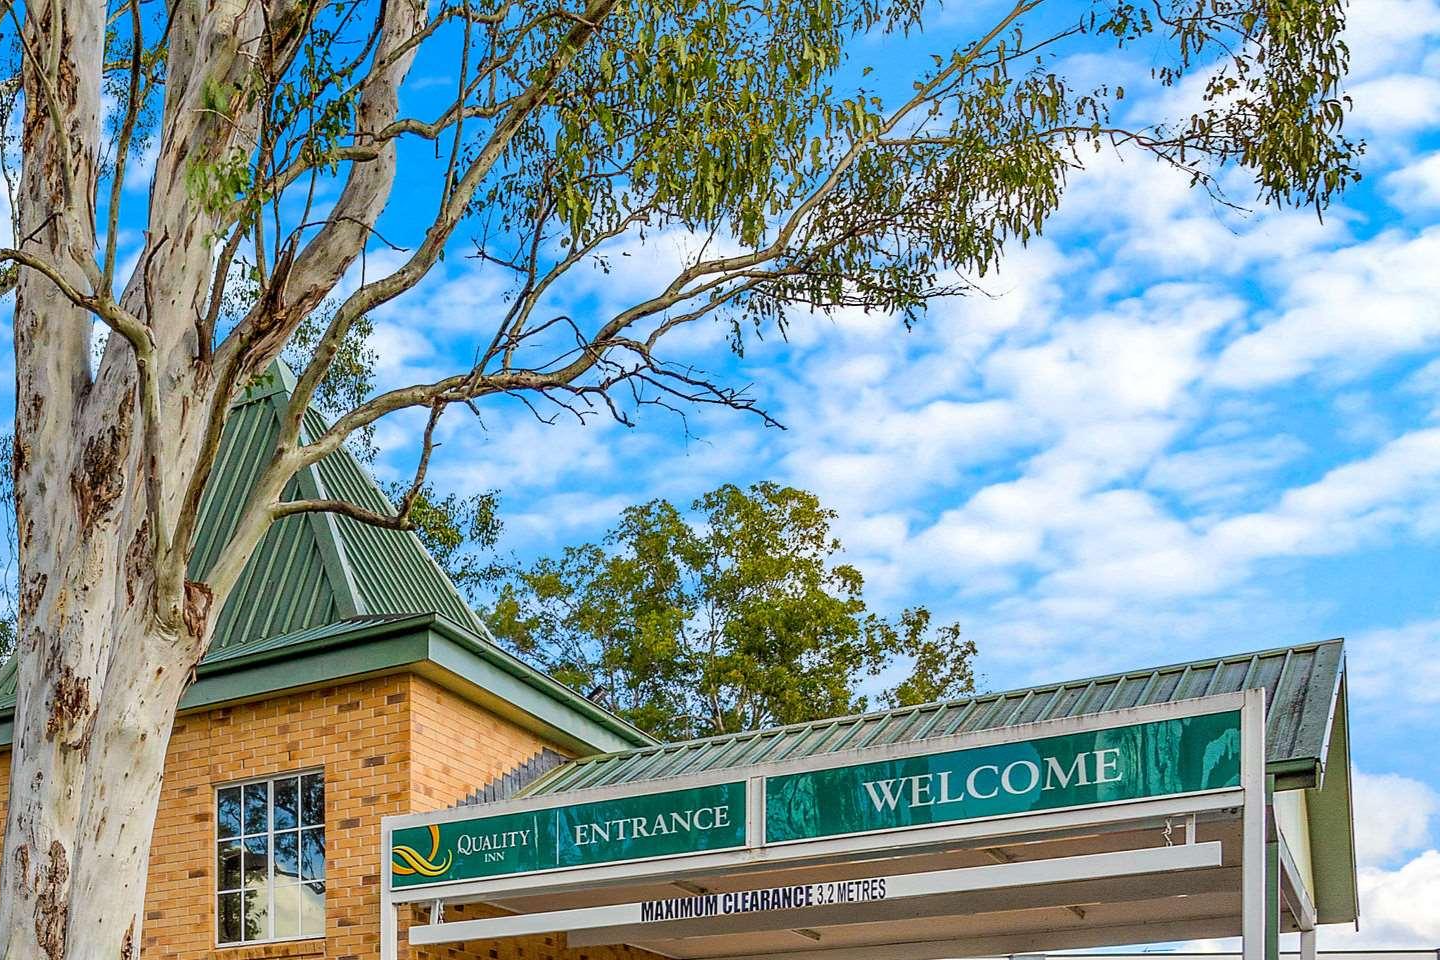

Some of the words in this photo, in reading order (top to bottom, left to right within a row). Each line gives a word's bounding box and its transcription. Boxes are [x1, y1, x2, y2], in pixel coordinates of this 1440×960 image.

[863, 748, 1123, 813] WELCOME
[457, 829, 531, 856] QUALITY
[574, 806, 730, 847] ENTRANCE
[484, 851, 505, 863] INN
[641, 895, 718, 922] MAXIMUM
[722, 886, 813, 915] CLEARANCE
[816, 883, 834, 905] 3.2
[837, 878, 887, 903] METRES
